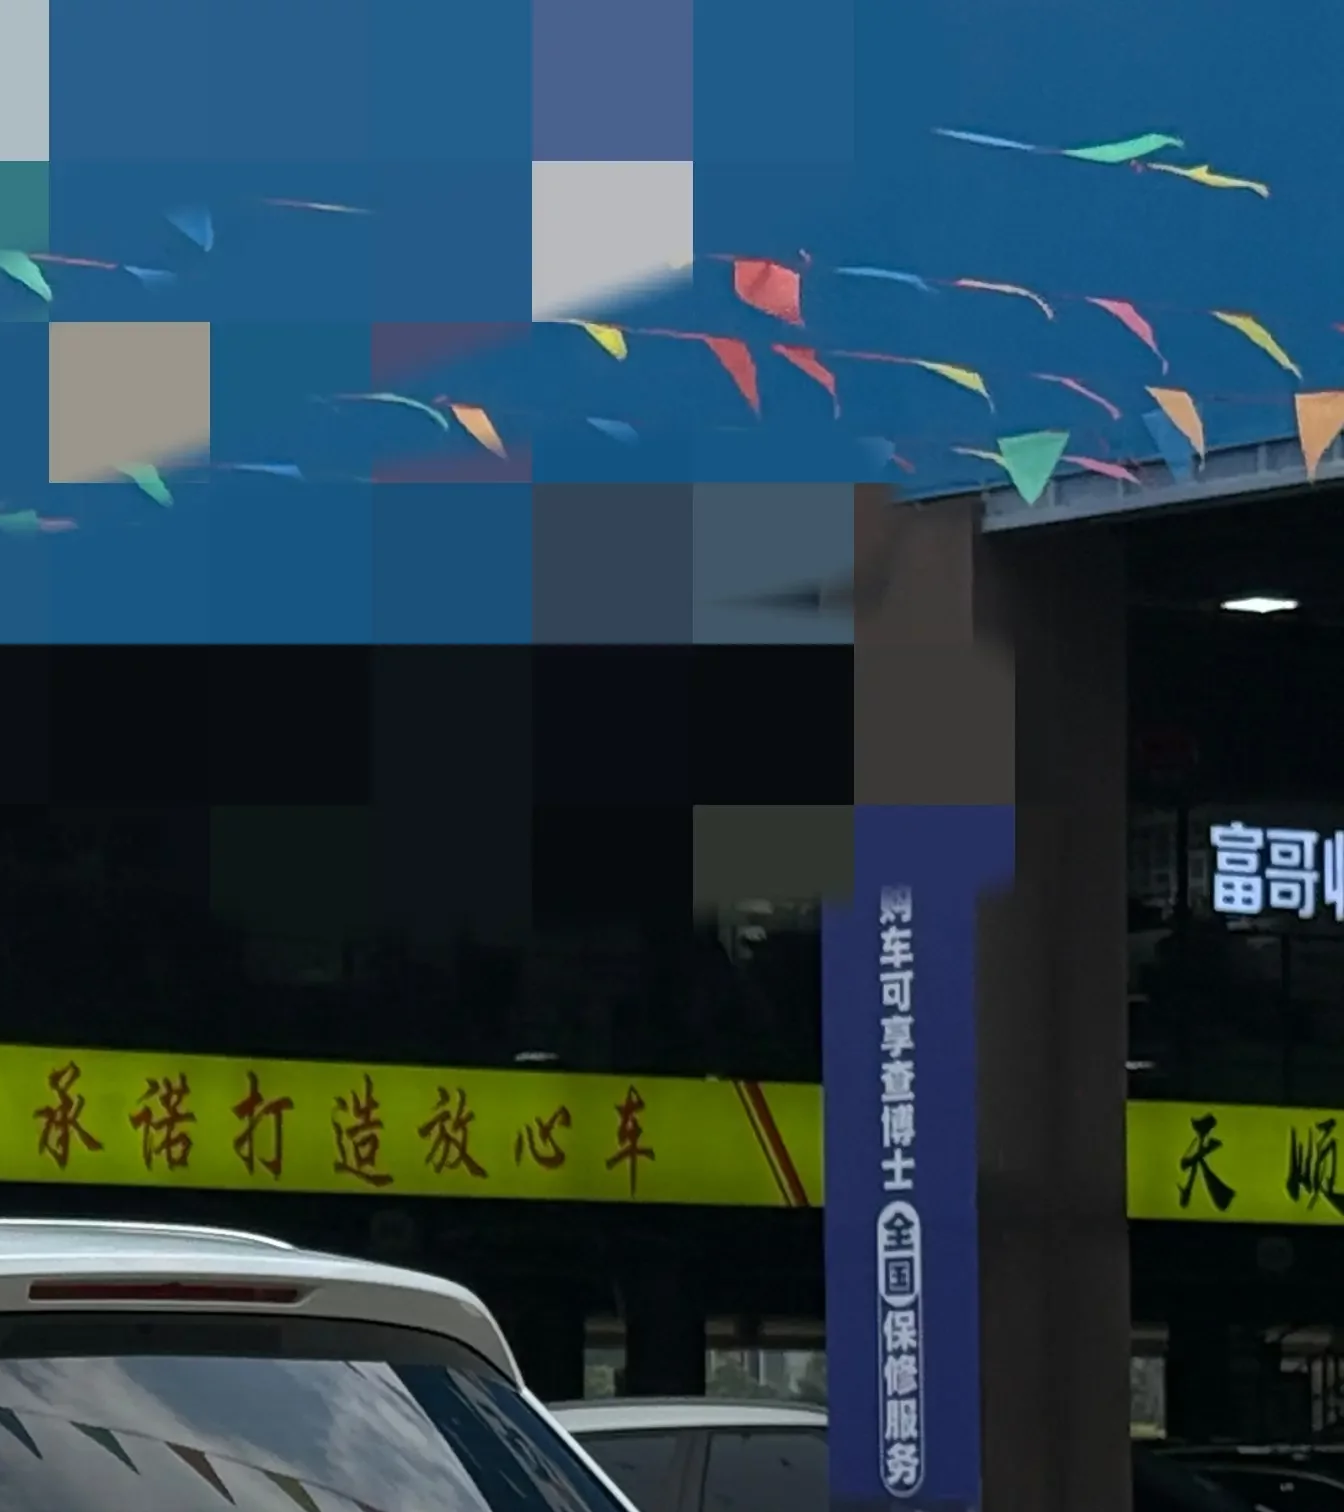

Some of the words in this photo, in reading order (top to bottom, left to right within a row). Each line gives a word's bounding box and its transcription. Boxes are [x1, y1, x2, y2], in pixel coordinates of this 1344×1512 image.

[33, 1060, 657, 1197] 承诺打造放心车
[1177, 1113, 1344, 1212] 天顺
[882, 1211, 920, 1487] 全国保修服务
